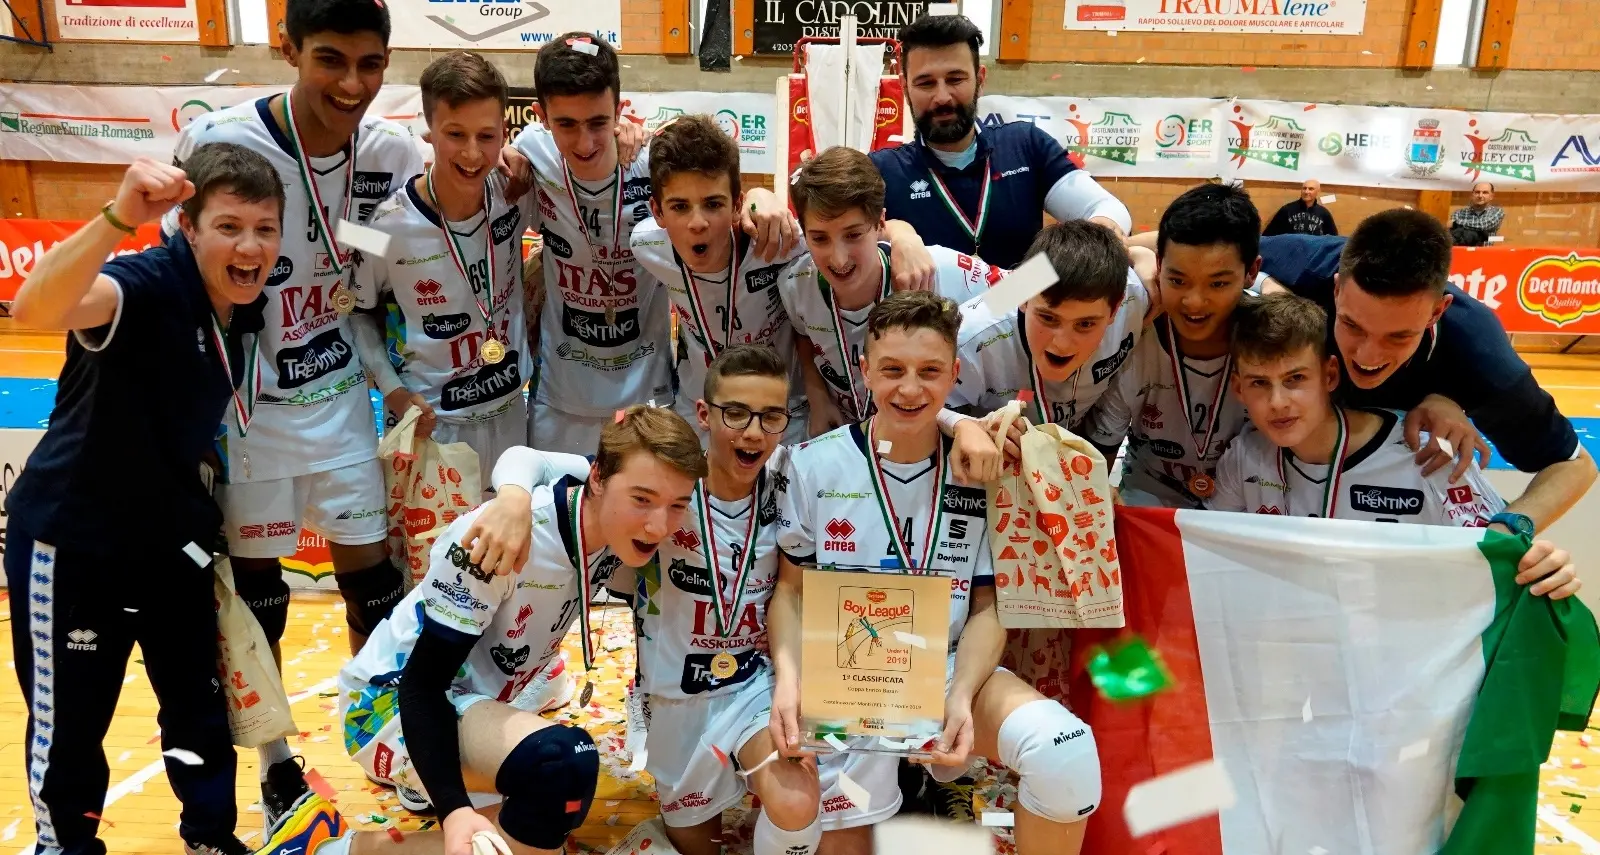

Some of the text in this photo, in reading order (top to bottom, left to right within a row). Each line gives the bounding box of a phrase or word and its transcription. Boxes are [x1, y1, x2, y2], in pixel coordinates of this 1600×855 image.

[479, 4, 523, 19] Group
[764, 0, 785, 23] IL
[62, 15, 194, 29] Tradizione di eccellenza
[1218, 19, 1247, 27] DOLORE
[1066, 135, 1140, 146] VOLLEY CUP
[1276, 140, 1302, 150] CUP
[1460, 151, 1534, 163] VOLLEY CUP
[352, 181, 390, 194] RENTINO
[555, 259, 638, 297] ITAS
[1529, 277, 1555, 294] Del
[1545, 295, 1582, 309] Quality
[424, 316, 469, 333] Melinda
[283, 340, 348, 381] TRENTINO
[448, 363, 518, 402] TRENTINO
[1194, 403, 1220, 434] 2
[824, 489, 873, 499] DIAMELT
[1354, 490, 1420, 509] TRENTINO
[943, 496, 987, 510] RENTINO
[940, 541, 971, 550] SEAT
[670, 568, 724, 589] Melin
[368, 582, 404, 607] molte
[843, 599, 911, 620] Boy League
[1087, 601, 1122, 614] DIFFEREN
[886, 656, 908, 665] 2019
[852, 675, 904, 684] CLASSIFICATA
[1053, 728, 1086, 746] MIKASA
